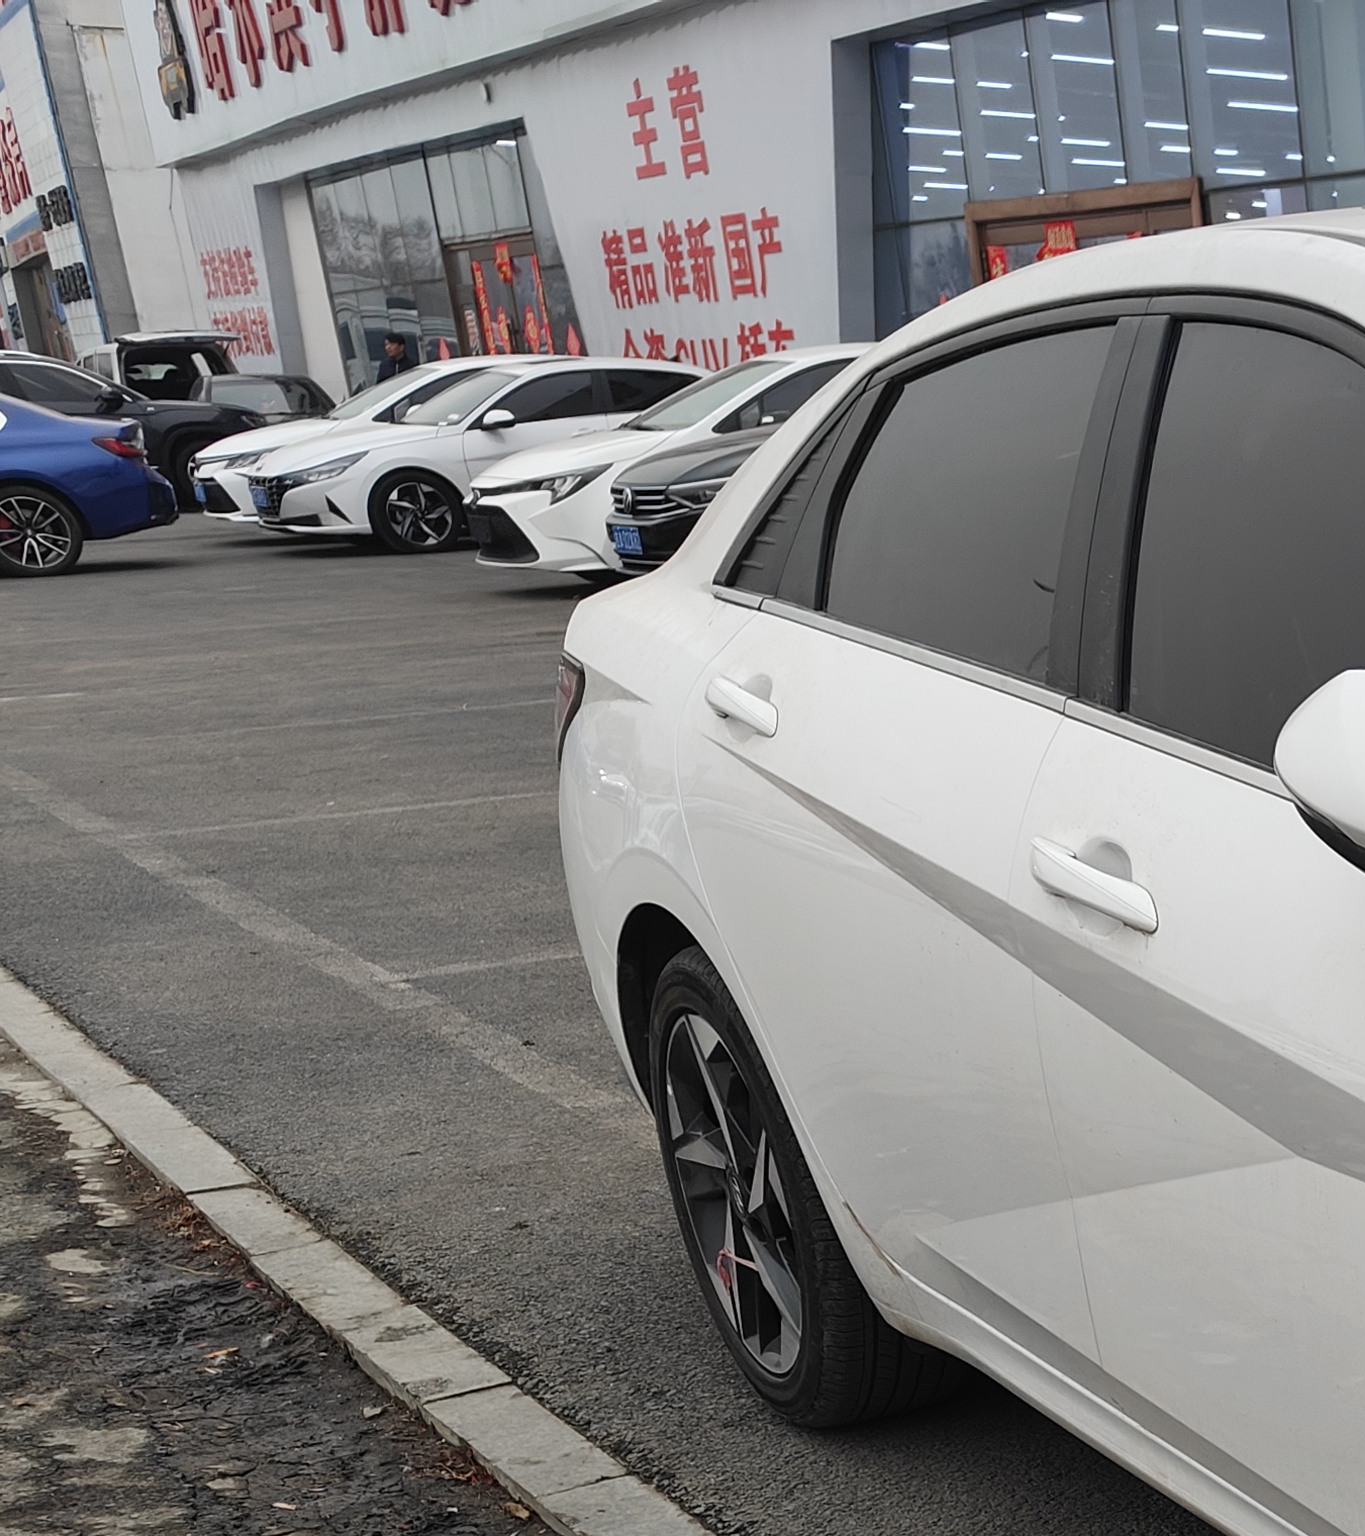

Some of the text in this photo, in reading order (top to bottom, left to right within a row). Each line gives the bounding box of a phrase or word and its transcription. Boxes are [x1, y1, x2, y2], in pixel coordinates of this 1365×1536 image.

[626, 65, 709, 180] 主营
[601, 207, 783, 310] 精品准新国产
